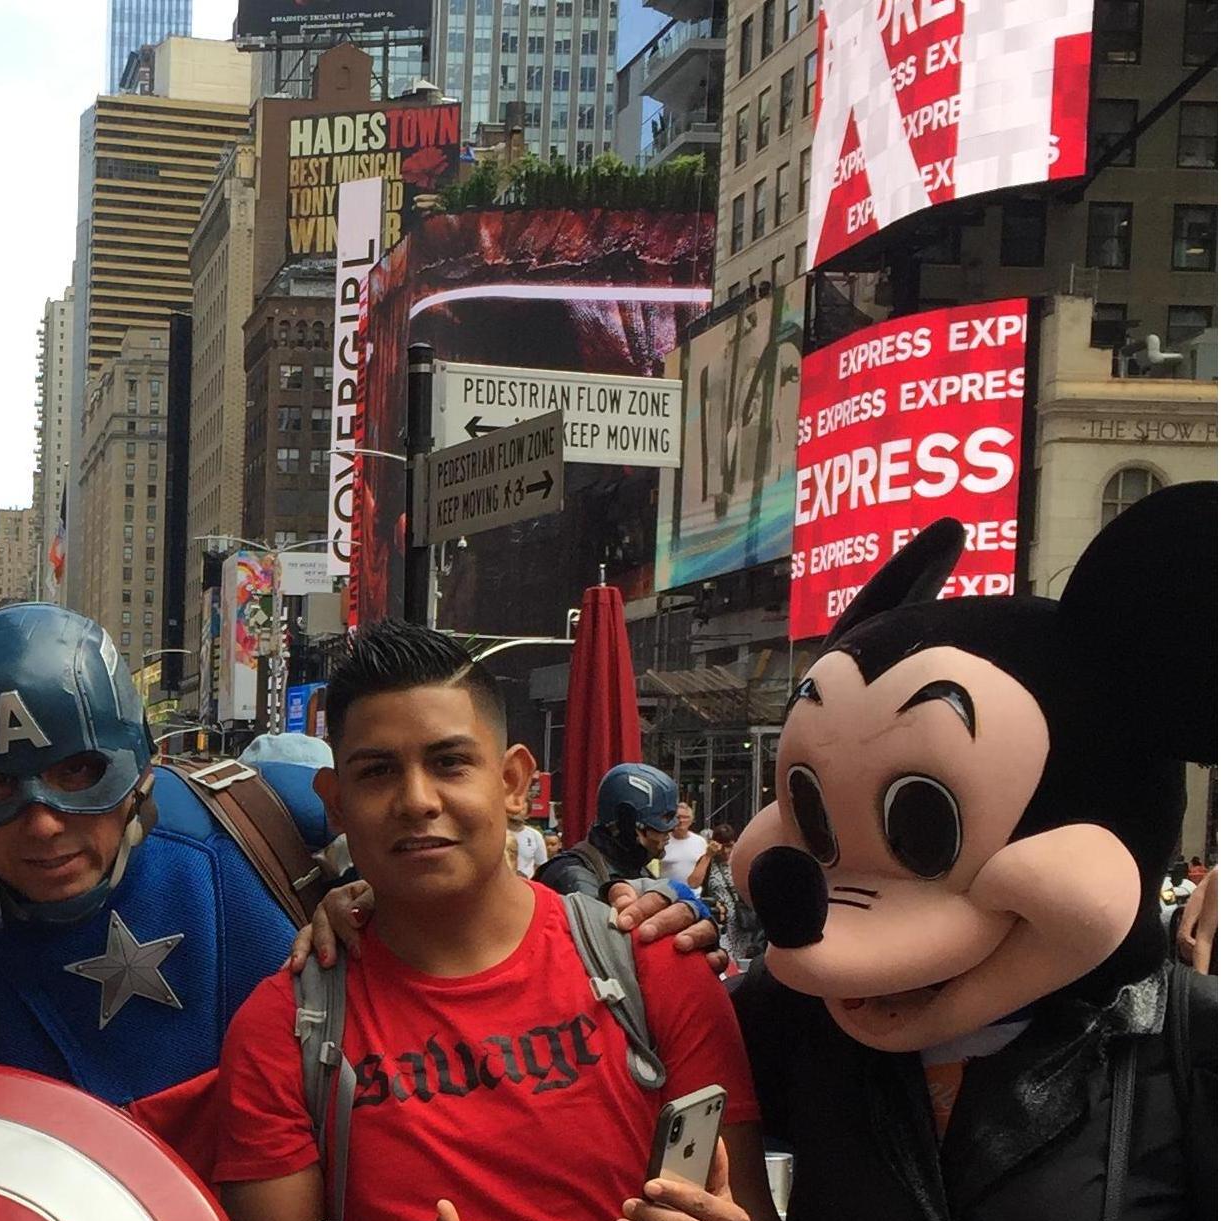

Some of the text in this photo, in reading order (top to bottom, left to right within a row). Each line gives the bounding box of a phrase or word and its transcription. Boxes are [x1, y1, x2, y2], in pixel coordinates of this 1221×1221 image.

[290, 151, 403, 187] BEST MUSICAL
[290, 185, 338, 217] TONY
[288, 211, 402, 255] WINR
[839, 327, 931, 380] EXPRESS
[464, 377, 671, 418] PEDESTRIAN FLOW ZONE
[817, 388, 887, 438] EXPRESS
[900, 367, 1025, 412] EXPRES
[563, 421, 670, 453] KEEP MOVING
[1089, 419, 1127, 439] THE
[1134, 420, 1197, 441] SHOW
[437, 427, 555, 490] PEDESTRIAN FLOW ZONE
[794, 426, 1015, 527] EXPRESS
[436, 484, 499, 528] KEEP MOVING
[810, 532, 880, 575] EXPRESS
[351, 1013, 603, 1109] savage
